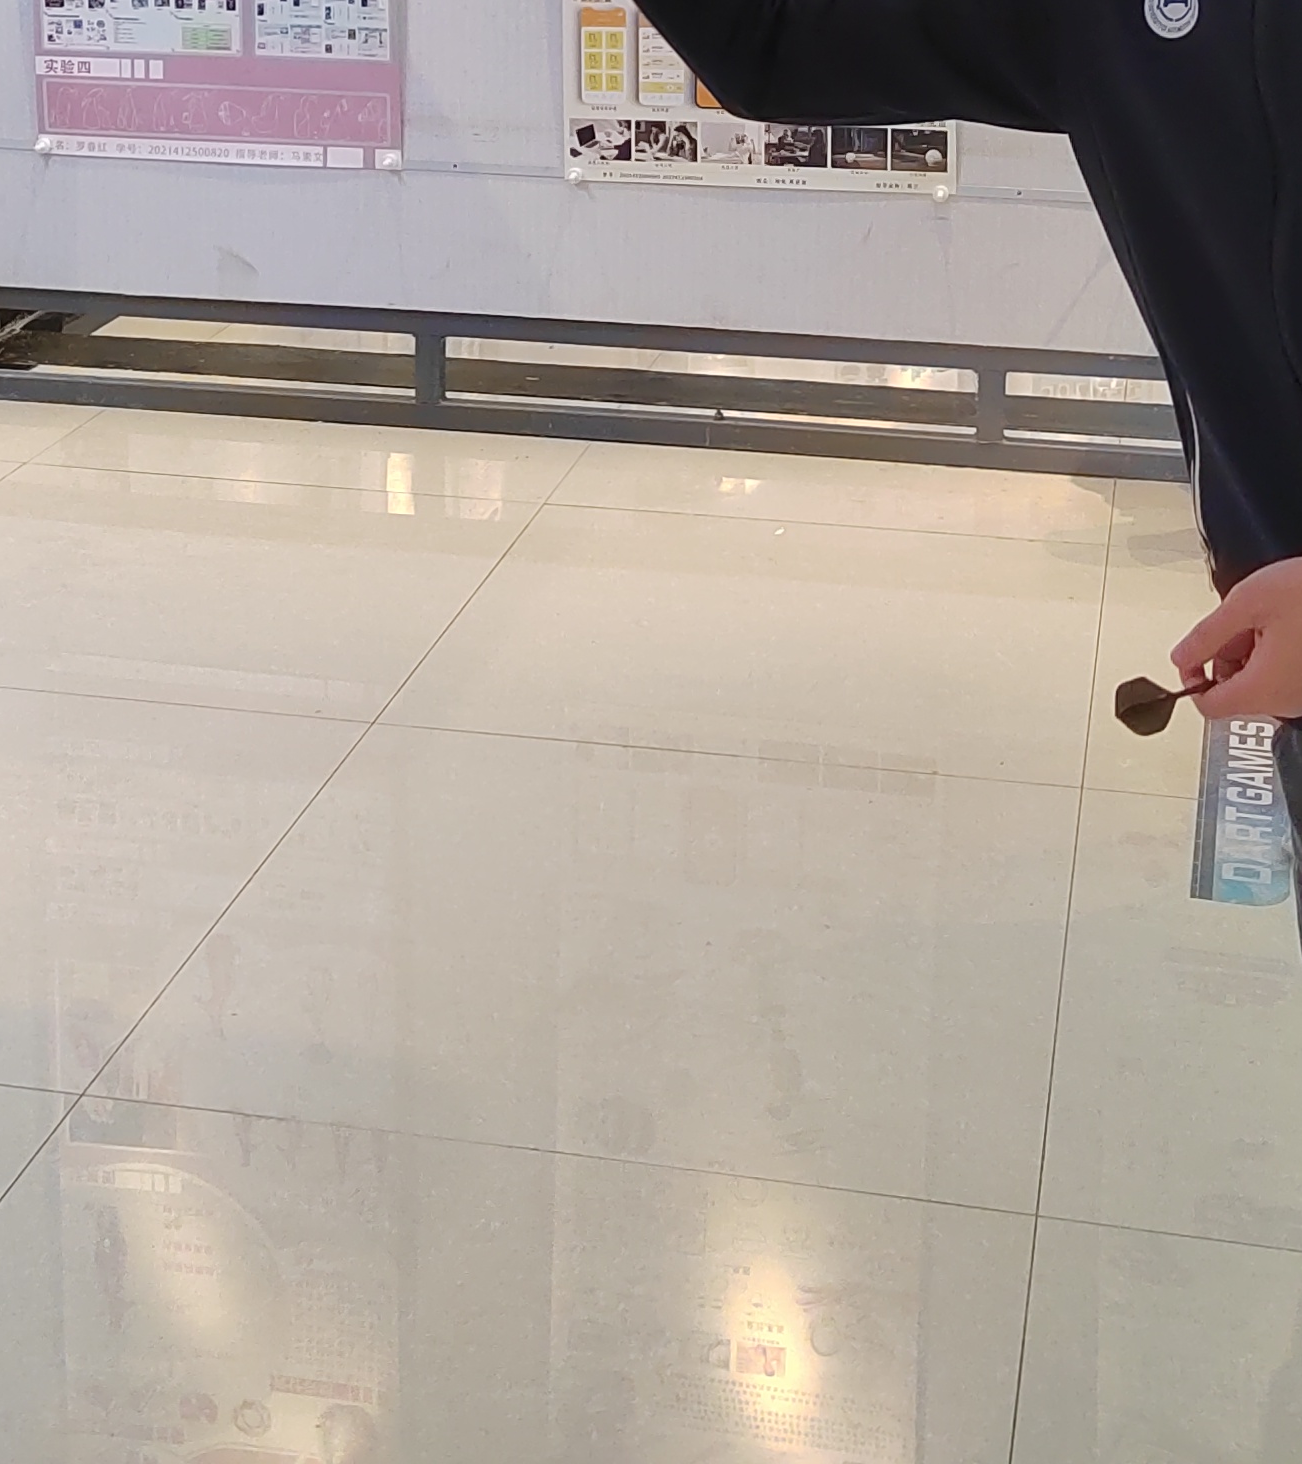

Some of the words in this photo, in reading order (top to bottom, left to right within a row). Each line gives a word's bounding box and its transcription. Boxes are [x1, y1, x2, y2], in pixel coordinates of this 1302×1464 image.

[42, 58, 92, 76] 实验四
[1225, 719, 1277, 806] GAMES
[1221, 805, 1276, 885] DART
